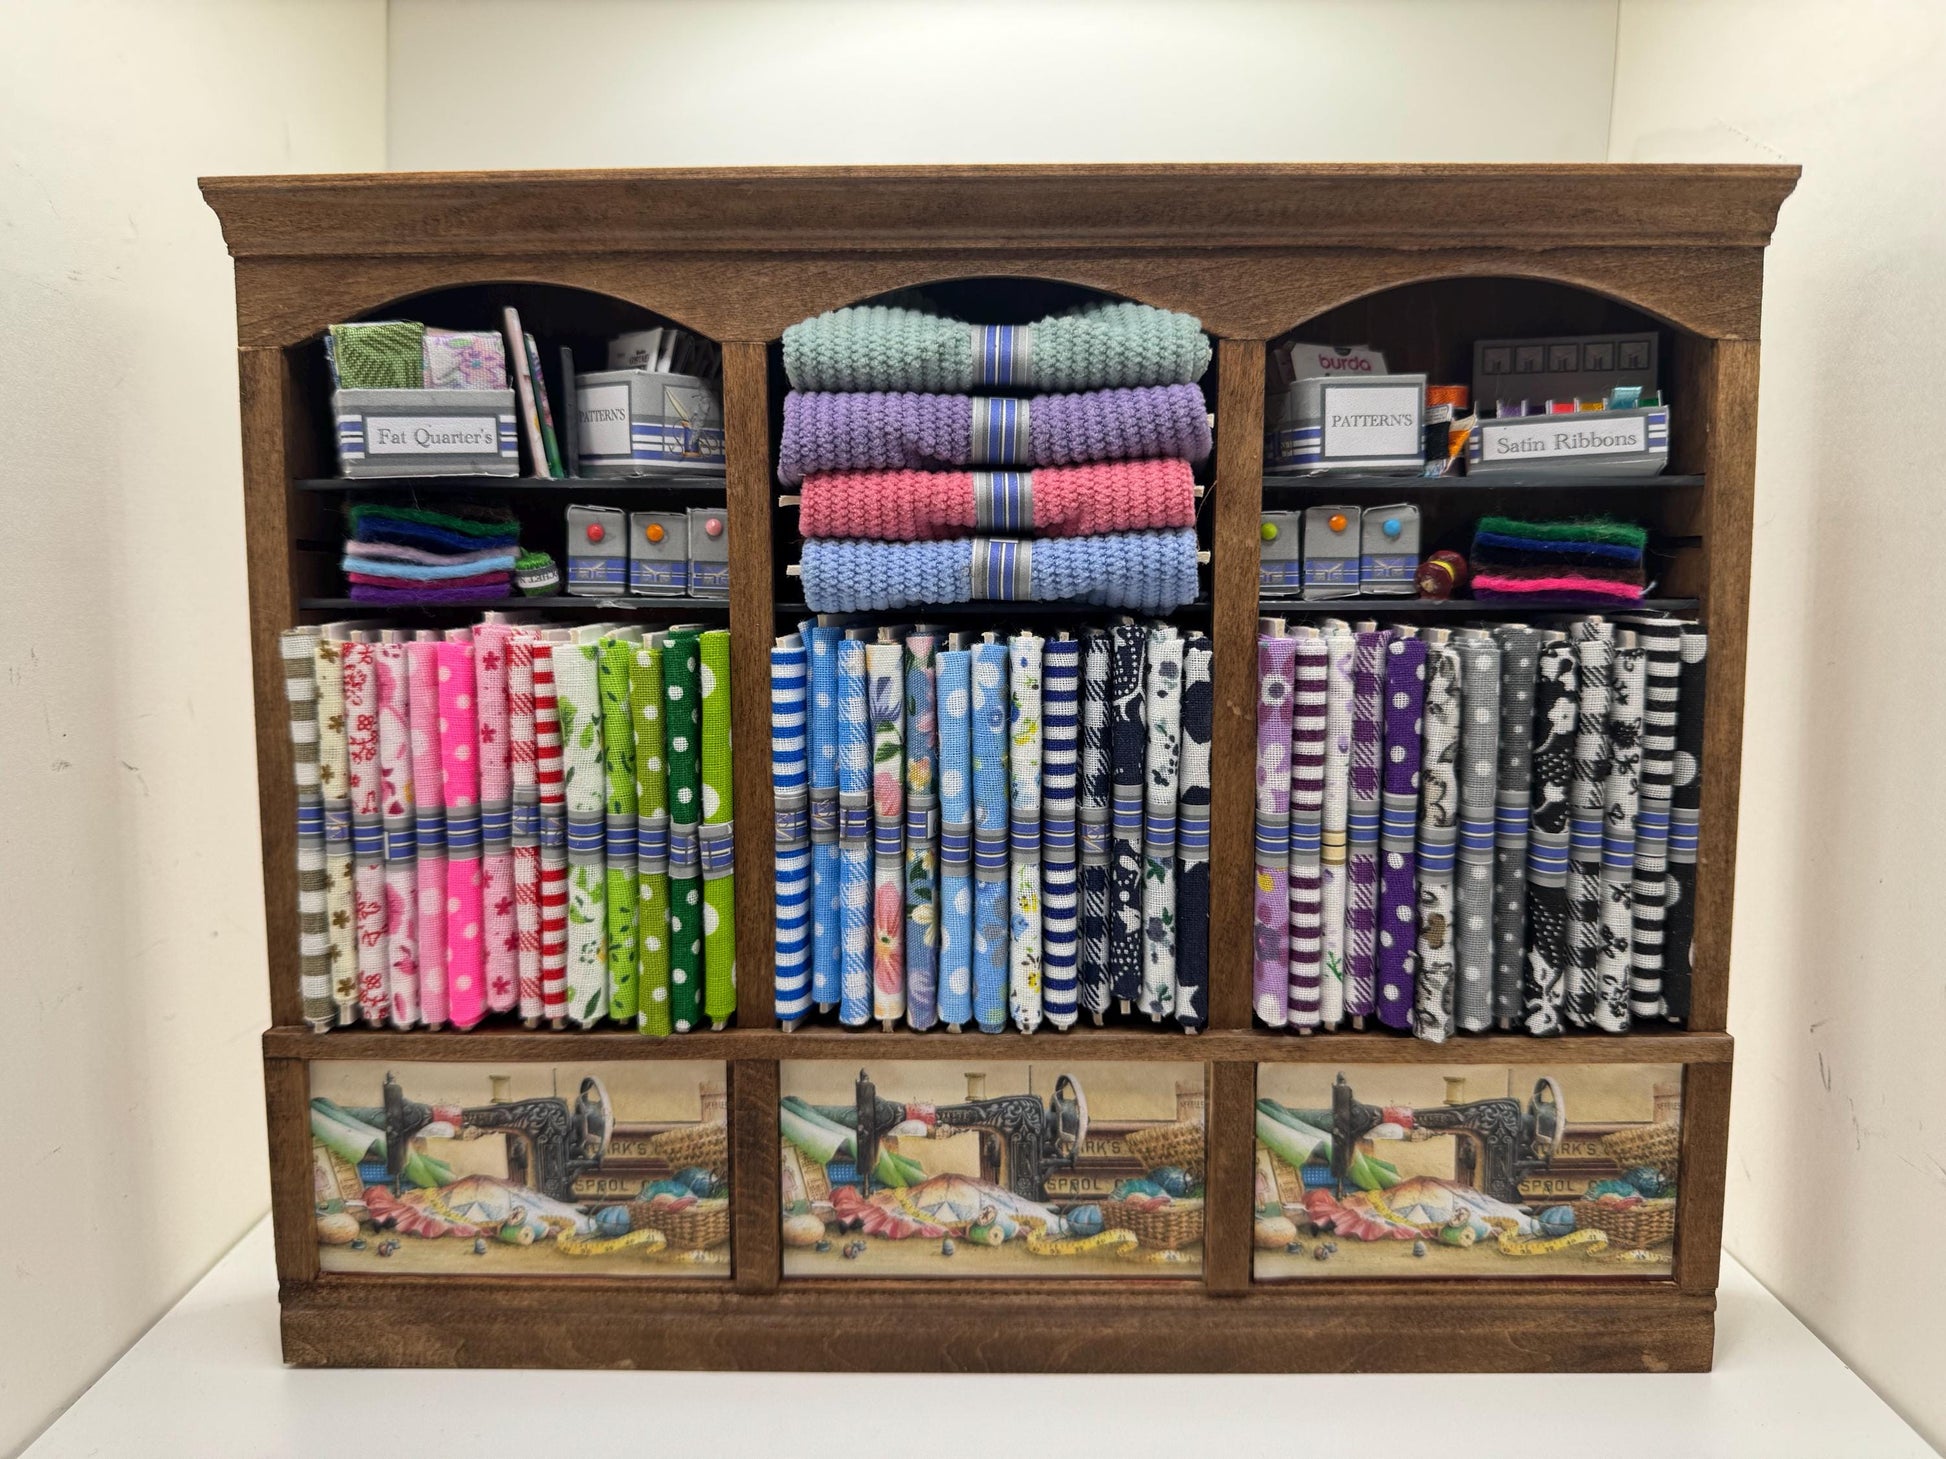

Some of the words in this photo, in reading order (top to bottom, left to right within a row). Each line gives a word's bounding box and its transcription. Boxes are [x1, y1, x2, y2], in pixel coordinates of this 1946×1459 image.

[1318, 354, 1372, 372] burda
[579, 408, 626, 423] PATTERN'S
[1331, 414, 1413, 428] PATTERN'S
[377, 428, 407, 445] Fat
[414, 428, 493, 448] Quarter's
[1497, 437, 1545, 454] Satin
[1553, 431, 1637, 450] Ribbons
